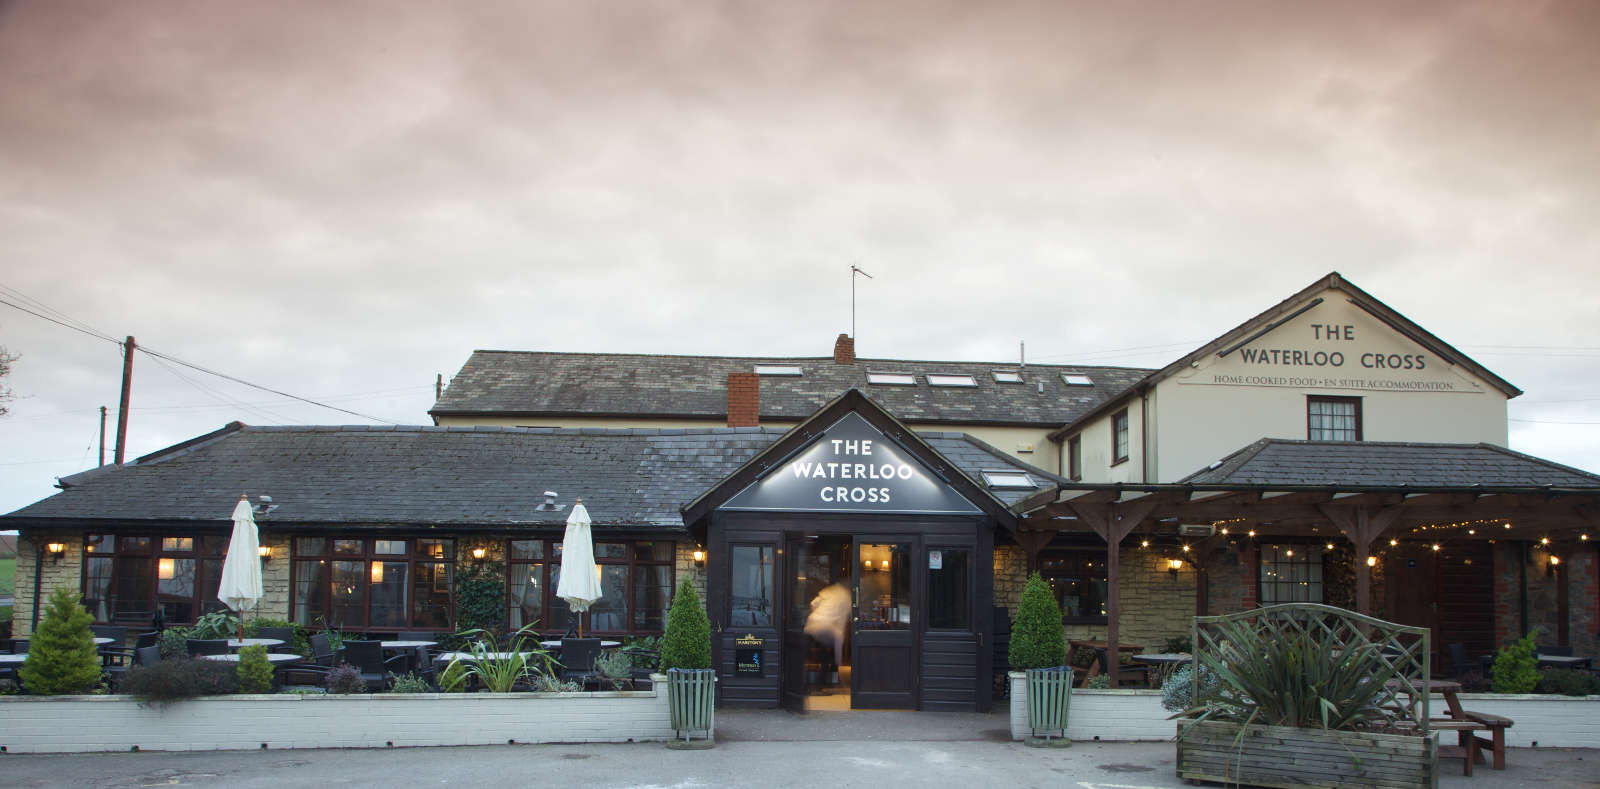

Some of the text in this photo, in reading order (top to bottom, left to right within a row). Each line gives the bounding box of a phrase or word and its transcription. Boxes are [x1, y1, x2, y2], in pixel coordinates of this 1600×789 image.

[1311, 324, 1355, 341] THE
[1240, 348, 1426, 370] WATERLOO CROSS
[1213, 375, 1454, 391] HOME COOKED FOOD EN SUITE ACCOMMODATION
[831, 439, 873, 456] THE
[792, 462, 913, 480] WATERLOO
[820, 486, 891, 503] CROSS
